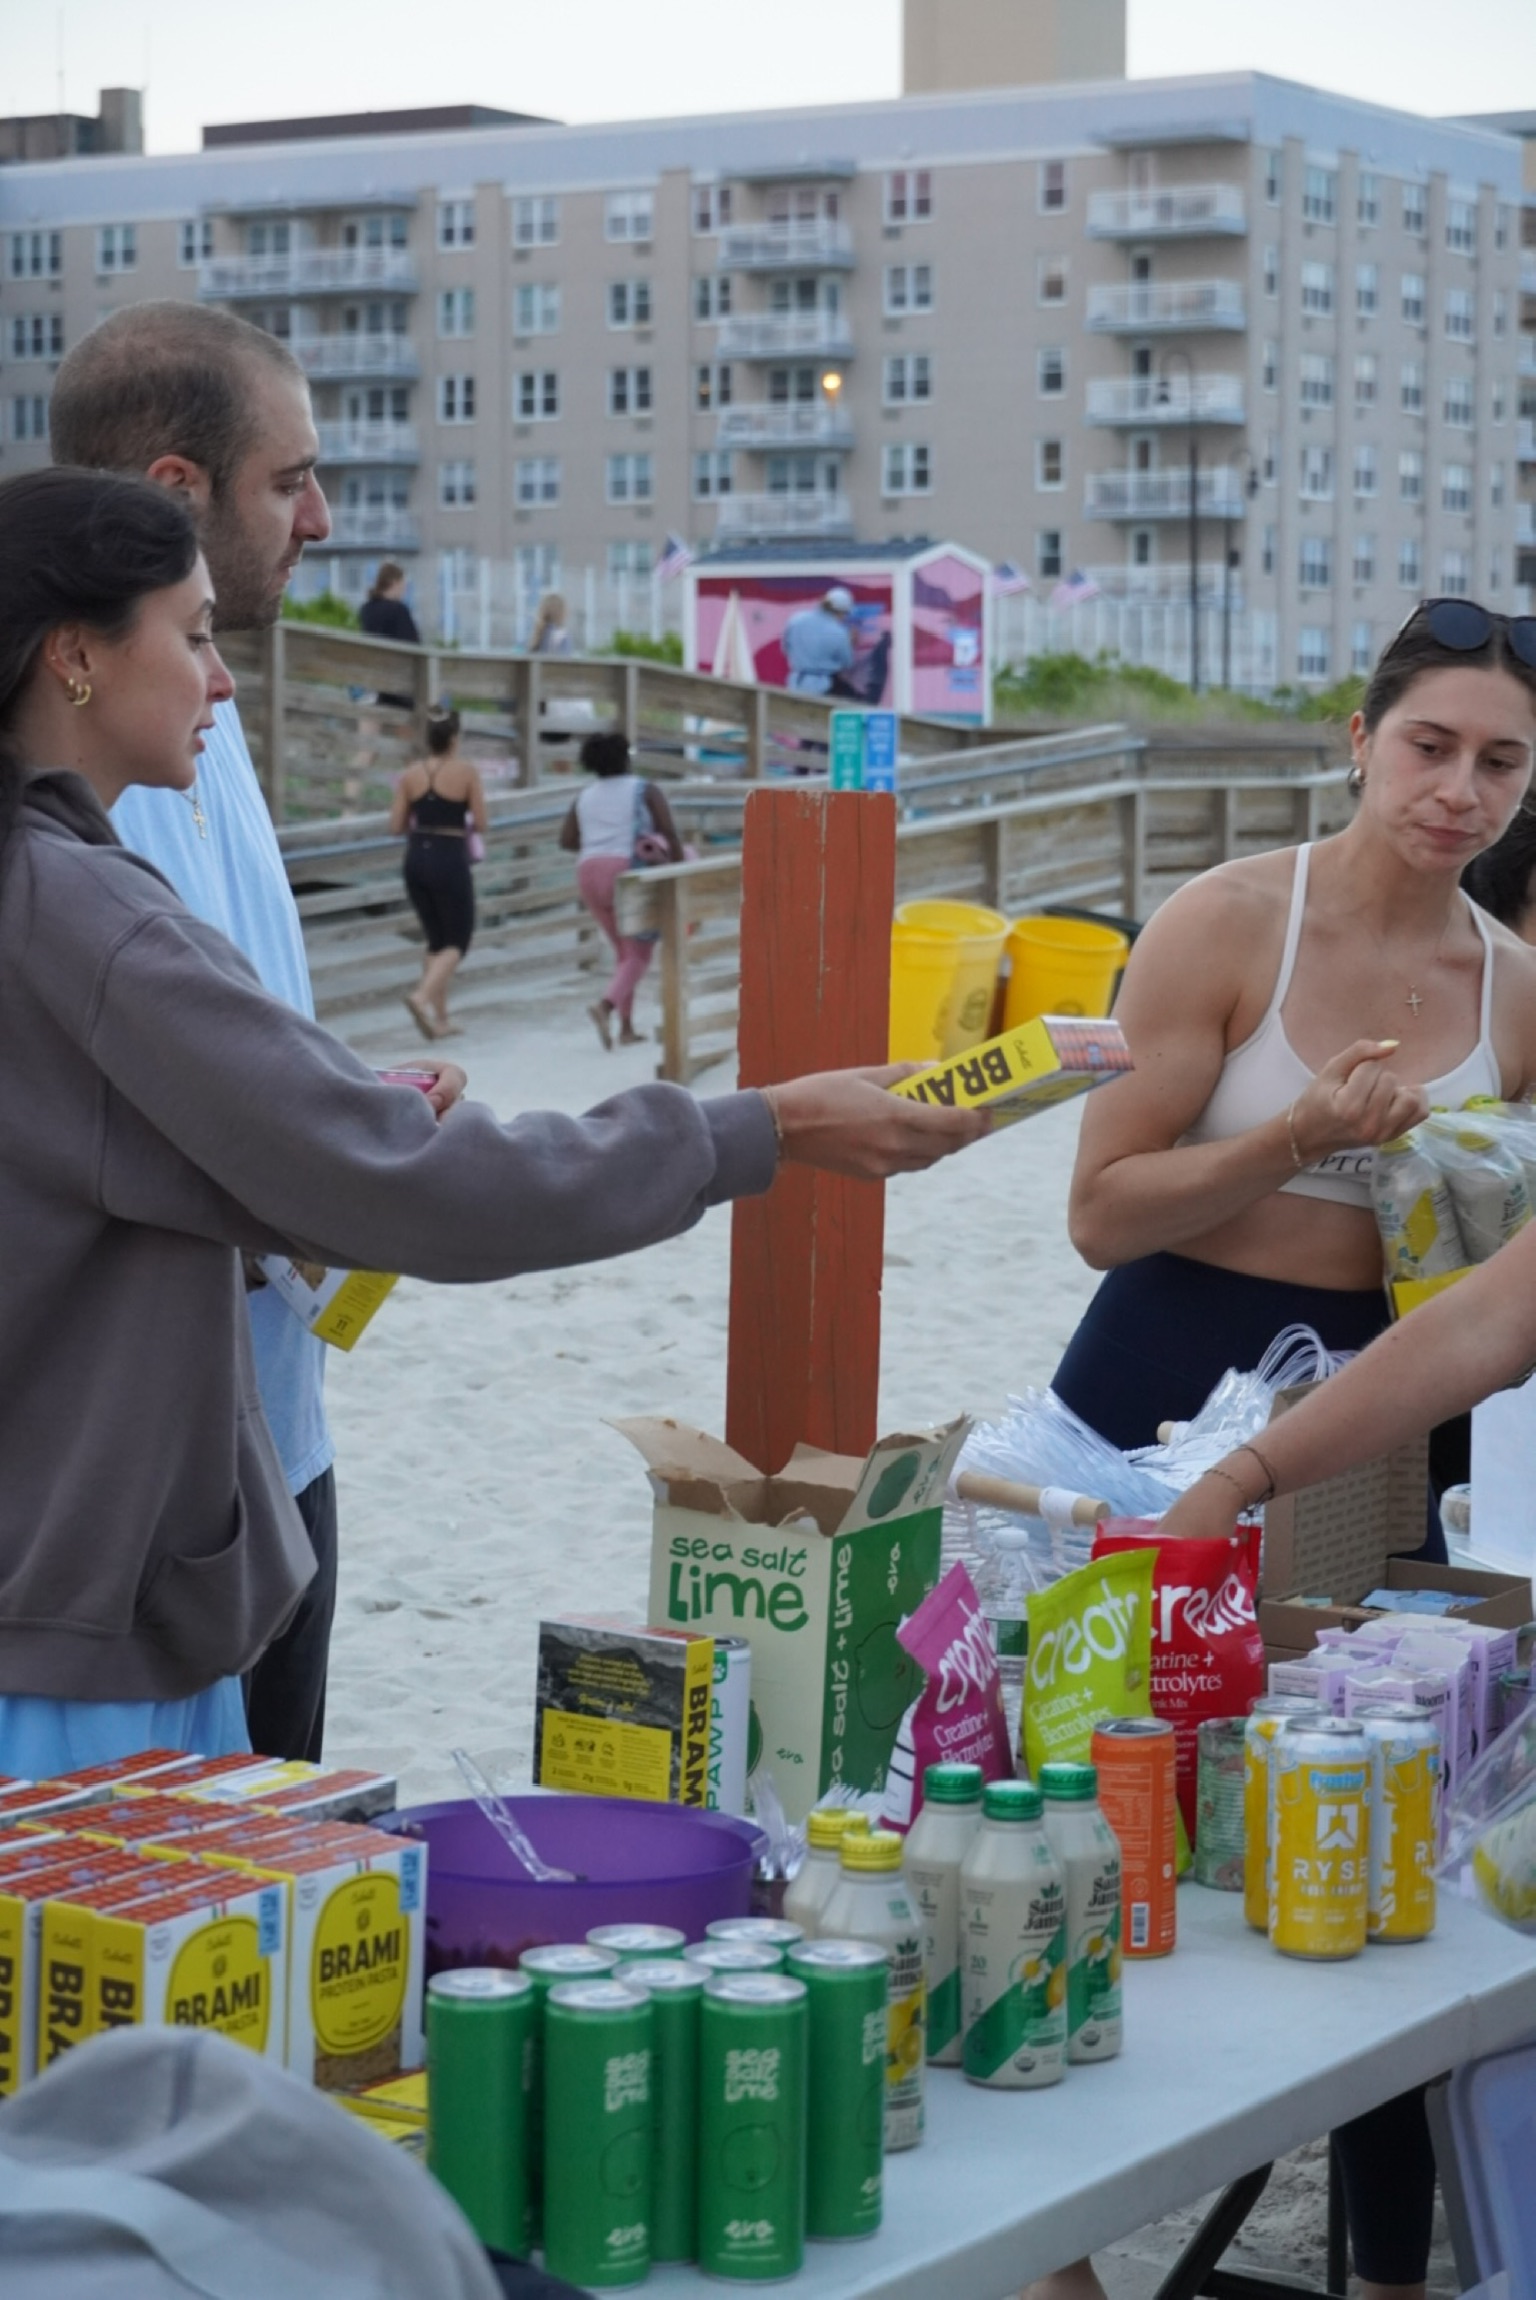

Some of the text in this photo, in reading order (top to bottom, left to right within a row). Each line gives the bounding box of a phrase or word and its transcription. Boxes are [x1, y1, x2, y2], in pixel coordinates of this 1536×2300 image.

[897, 1046, 1012, 1107] BRAM
[669, 1537, 807, 1578] sea salt
[1151, 1573, 1256, 1642] reate
[1150, 1652, 1199, 1670] atine
[1150, 1673, 1222, 1696] trolytes
[831, 1660, 849, 1737] salt
[684, 1684, 708, 1808] BRAM
[830, 1745, 843, 1786] ea
[320, 1928, 400, 1983] BRAMI
[48, 1959, 84, 2062] BRA
[175, 1972, 260, 2027] BRAMI
[726, 2049, 780, 2065] sea
